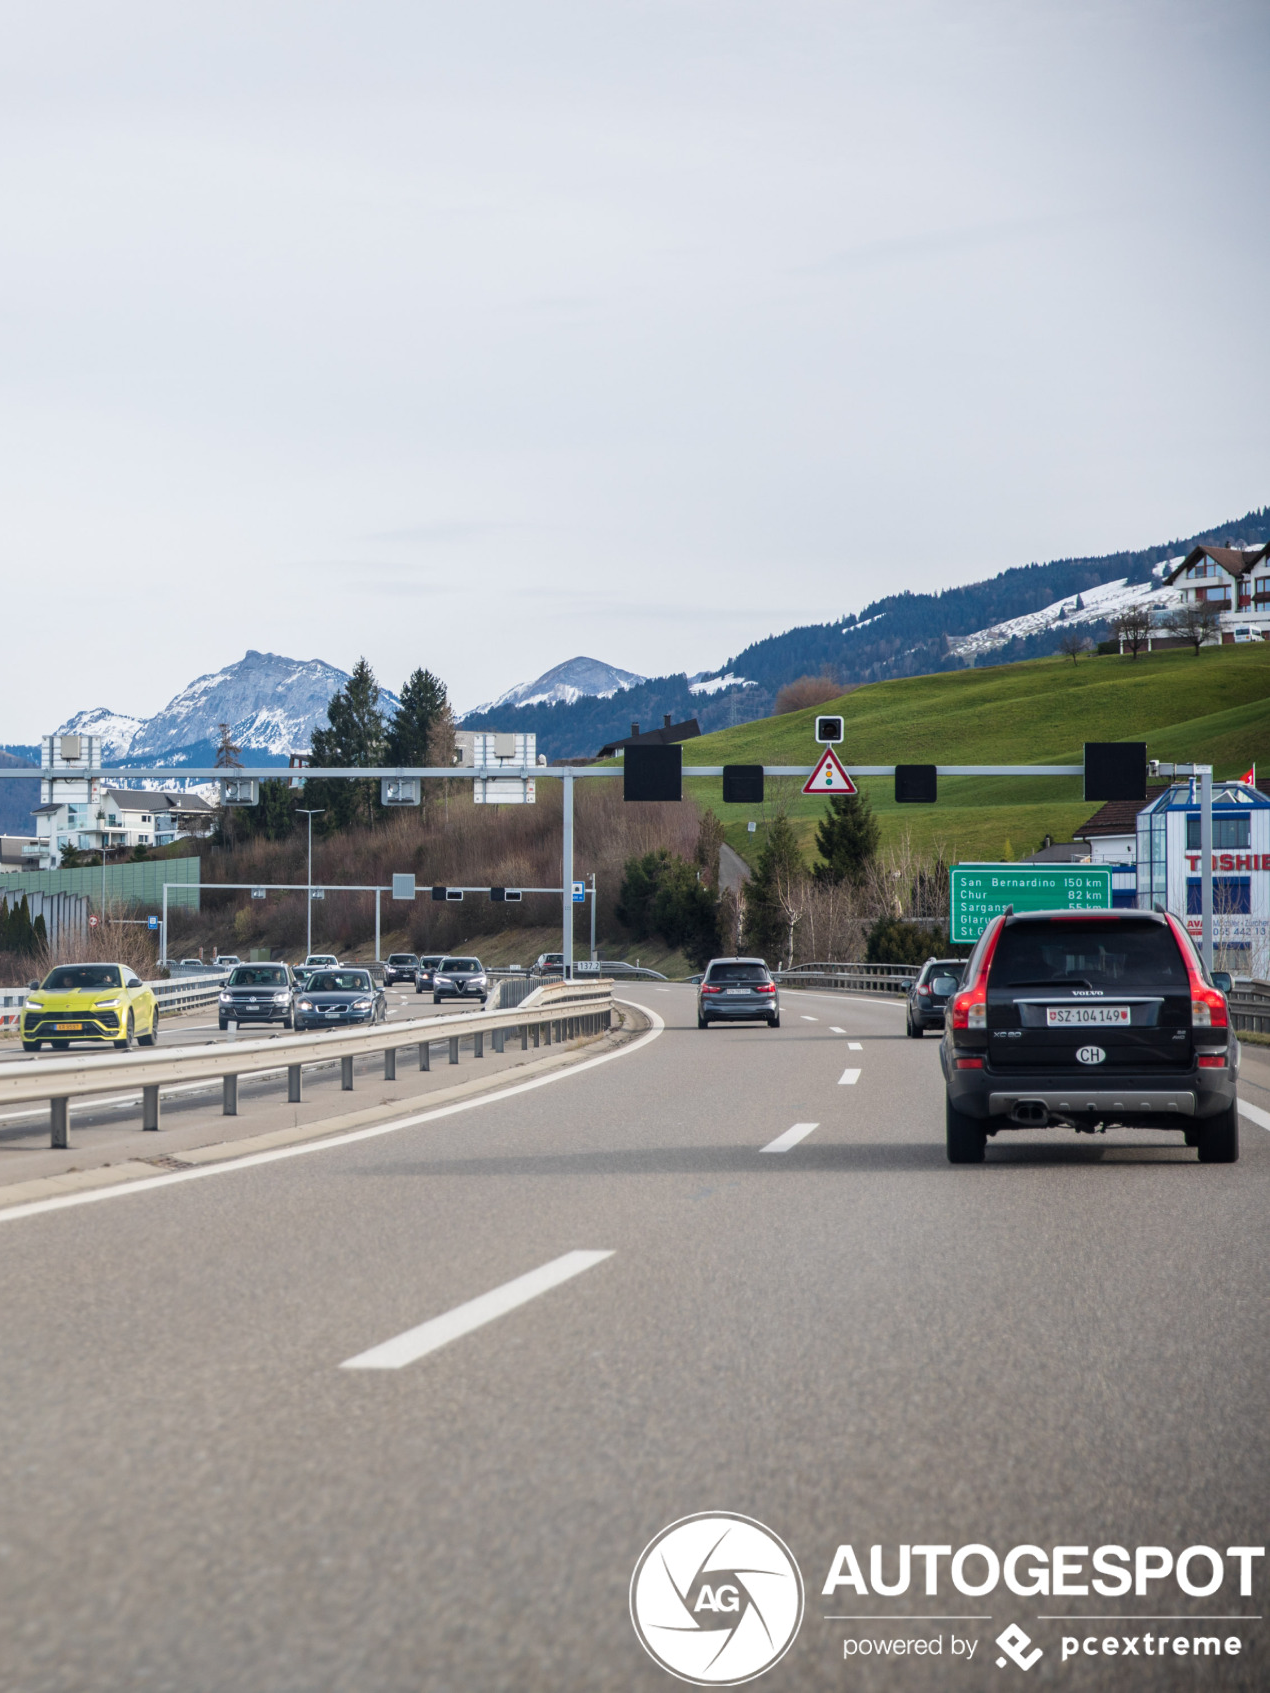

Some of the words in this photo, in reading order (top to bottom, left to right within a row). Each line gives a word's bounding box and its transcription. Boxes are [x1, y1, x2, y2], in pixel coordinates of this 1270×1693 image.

[960, 877, 982, 887] San
[991, 877, 1055, 887] Bernardino
[1064, 878, 1083, 887] 150
[1086, 878, 1102, 887] km
[960, 890, 987, 899] Chur
[1068, 890, 1083, 899] 82
[1086, 890, 1102, 899] km
[960, 902, 1006, 914] Sargans
[960, 915, 990, 924] Glaru
[960, 926, 984, 936] St.G
[580, 962, 600, 971] 137.2
[1080, 1048, 1100, 1062] CH
